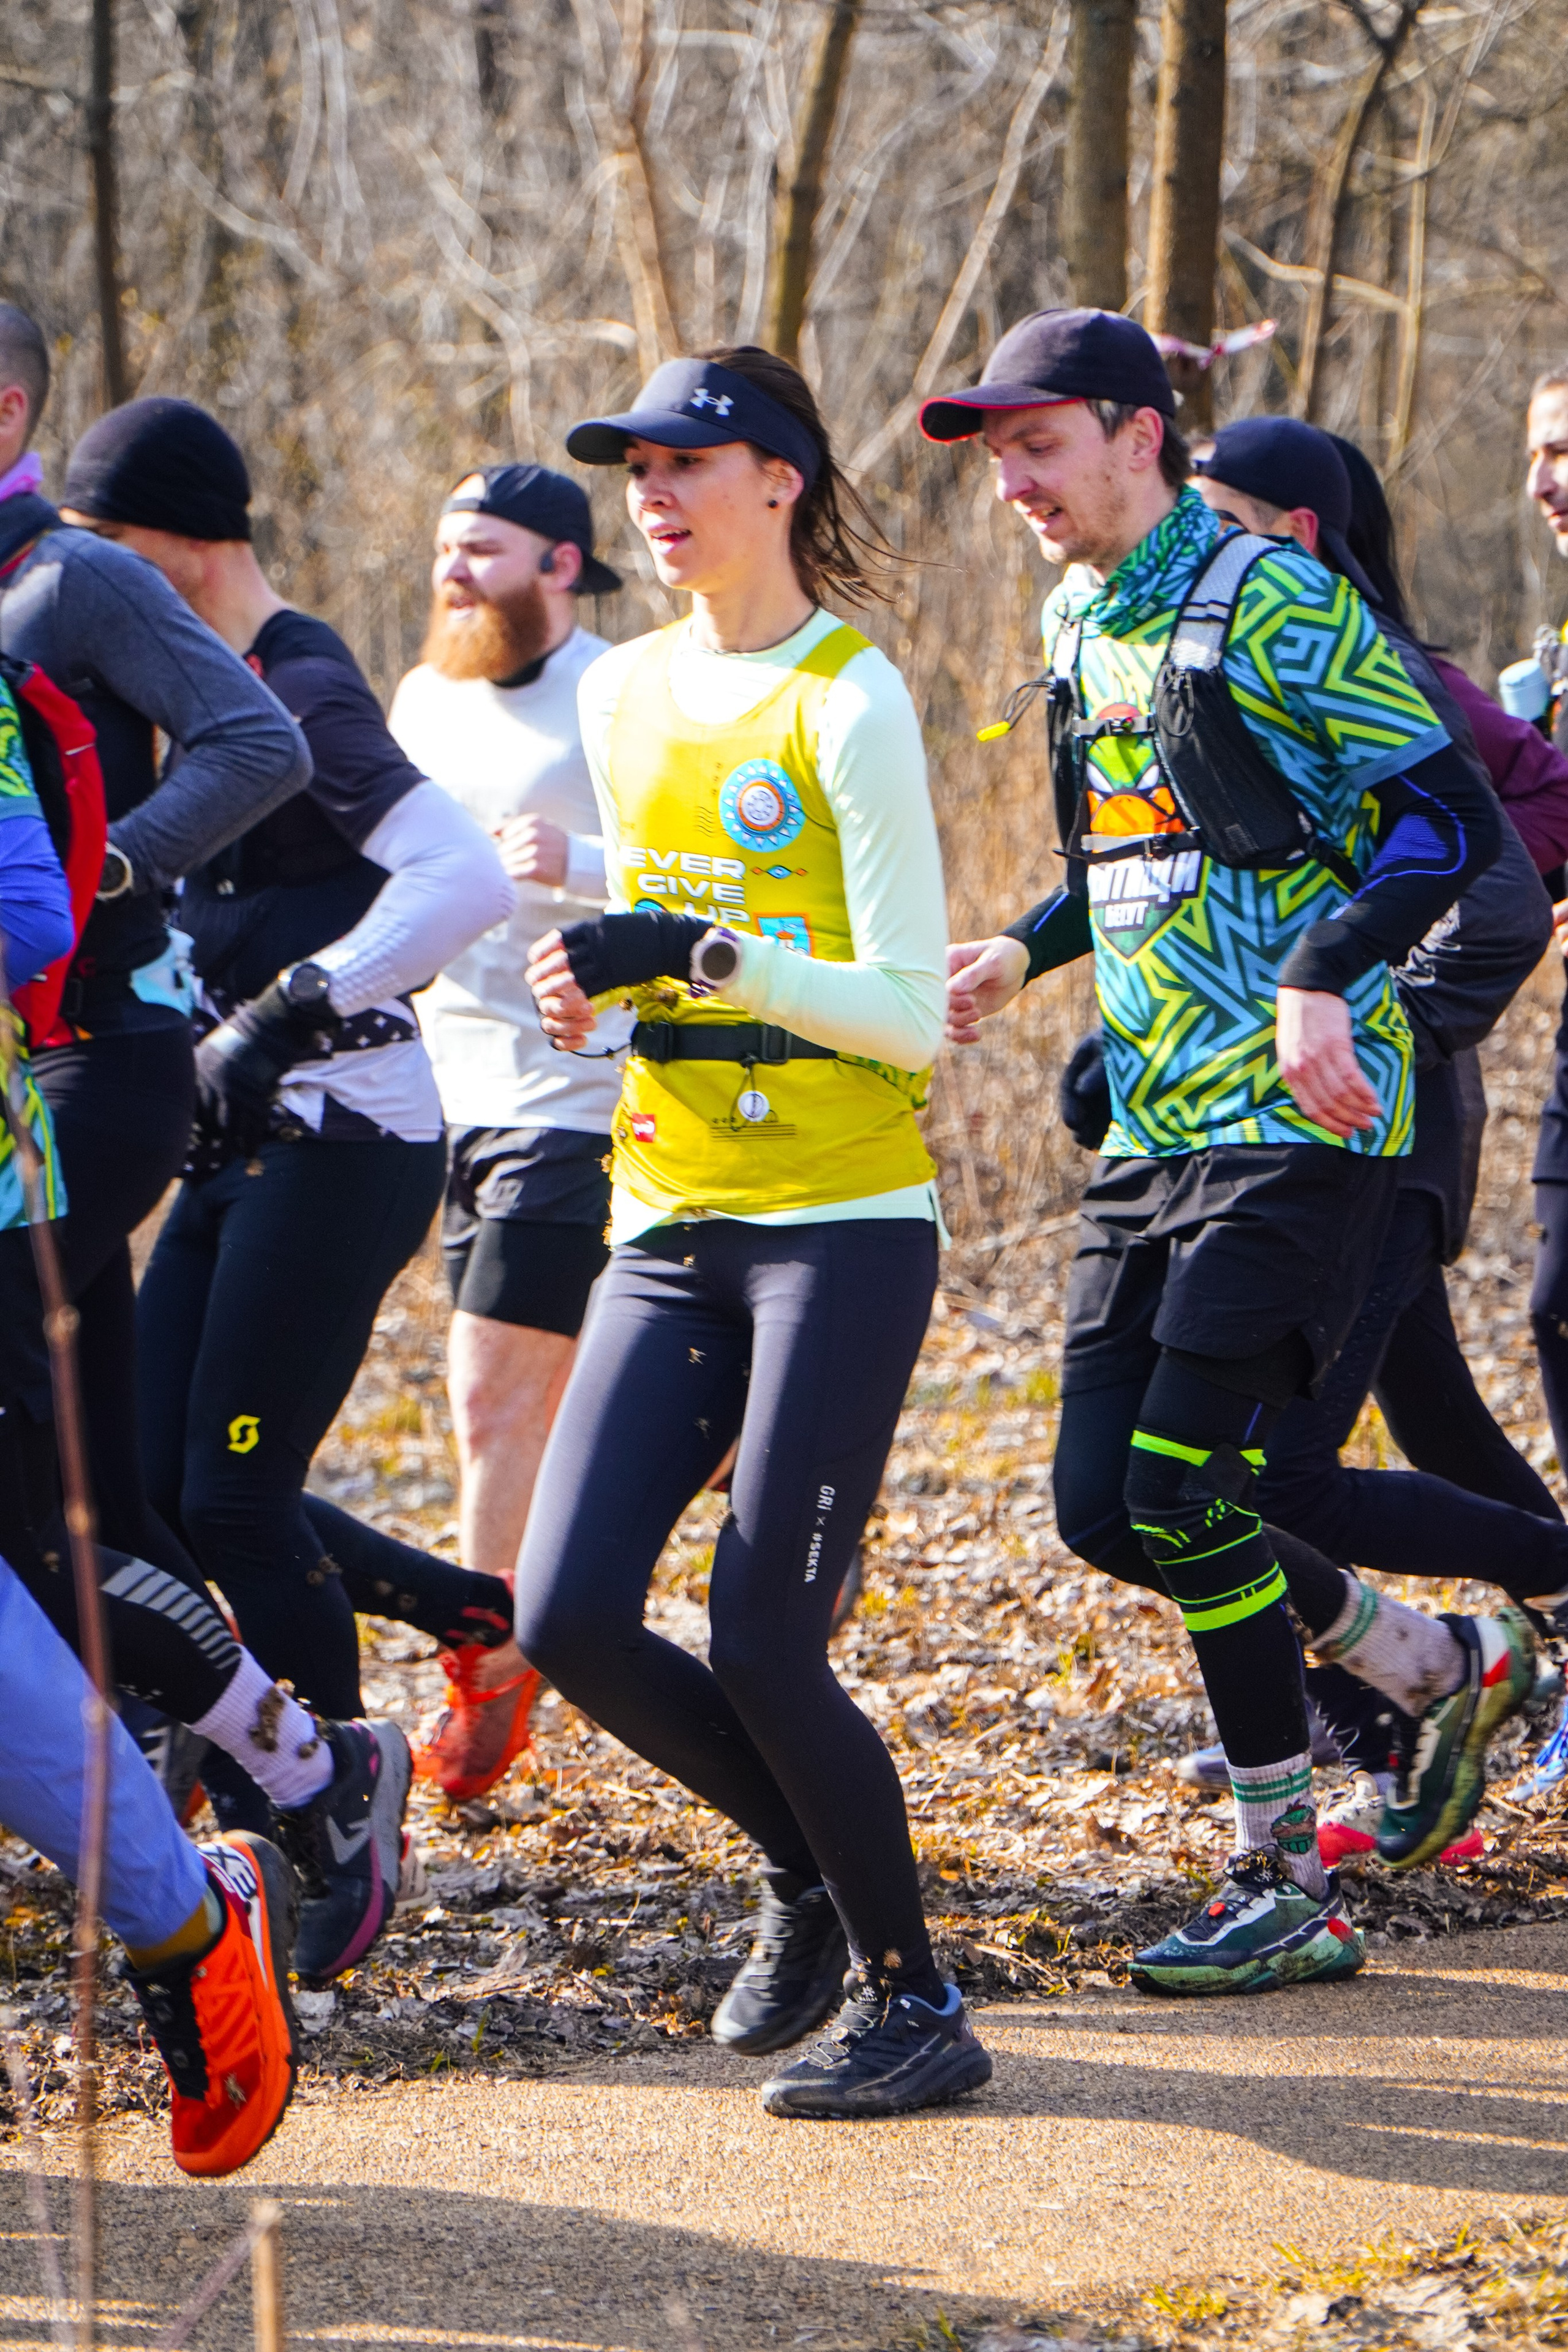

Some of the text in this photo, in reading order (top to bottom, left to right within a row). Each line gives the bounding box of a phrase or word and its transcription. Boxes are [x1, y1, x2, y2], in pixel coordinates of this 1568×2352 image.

[619, 845, 747, 880] EVER
[637, 873, 745, 905] GIVE
[684, 901, 751, 923] UP
